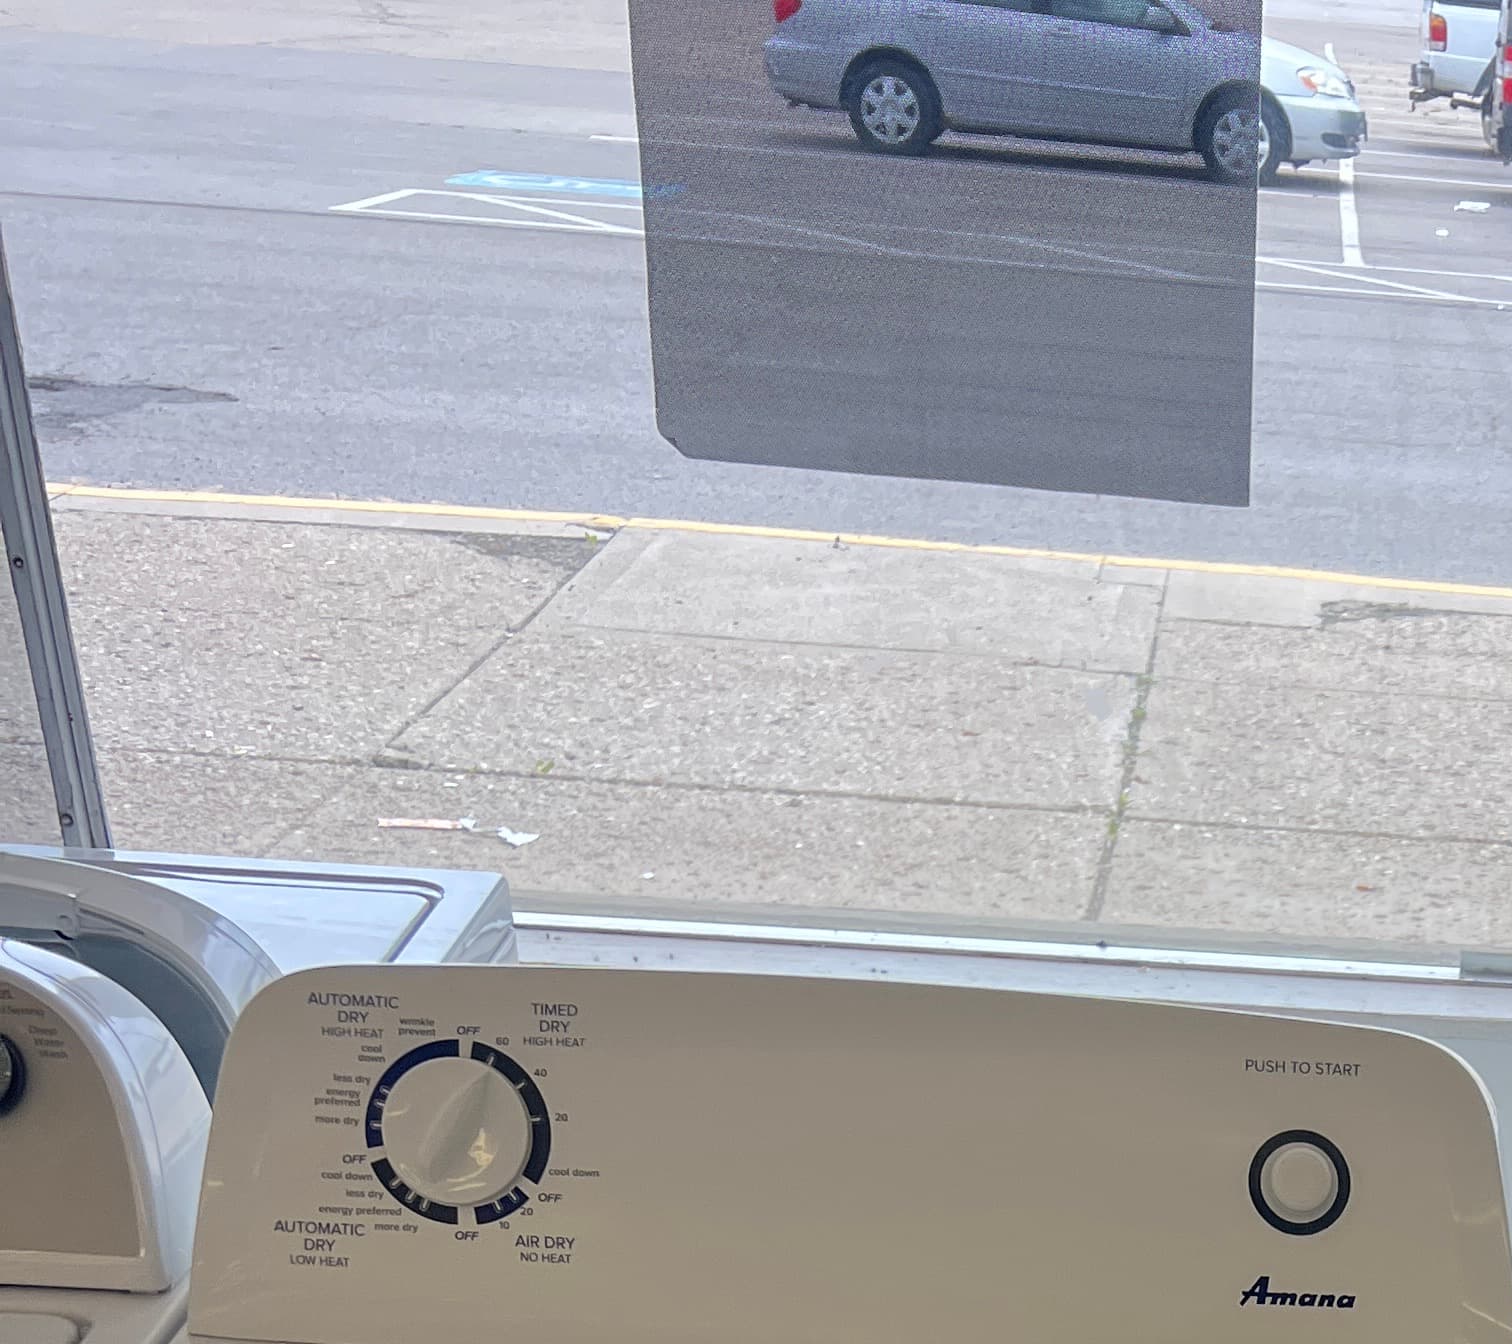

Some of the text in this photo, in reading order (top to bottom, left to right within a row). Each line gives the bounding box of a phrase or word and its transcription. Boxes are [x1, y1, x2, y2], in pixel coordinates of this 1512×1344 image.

[308, 992, 399, 1009] AUTOMATIC
[531, 1003, 578, 1017] TIMED
[337, 1010, 368, 1023] DRY
[456, 1026, 481, 1036] OFF
[539, 1020, 570, 1033] DRY
[321, 1027, 384, 1039] HIGH HEAT
[398, 1028, 436, 1037] prevent
[496, 1037, 510, 1046] 60
[523, 1037, 587, 1048] HIGH HEAT
[533, 1068, 548, 1078] 40
[1245, 1059, 1361, 1077] PUSH TO START
[355, 1074, 371, 1086] dry
[343, 1115, 360, 1127] dry
[555, 1112, 569, 1122] 20
[343, 1154, 367, 1165] OFF
[321, 1171, 374, 1181] cool down
[548, 1168, 600, 1178] cool down
[367, 1190, 384, 1200] dry
[538, 1192, 562, 1203] OFF
[318, 1205, 402, 1217] energy preferred
[520, 1207, 534, 1216] 20
[274, 1220, 366, 1236] AUTOMATIC
[374, 1223, 419, 1234] more dry
[499, 1221, 511, 1230] 10
[454, 1230, 480, 1241] OFF
[304, 1238, 336, 1252] DRY
[515, 1234, 575, 1250] AIR DRY
[290, 1254, 350, 1268] LOW HEAT
[520, 1251, 572, 1264] NO HEAT
[1240, 1275, 1356, 1309] Amana
